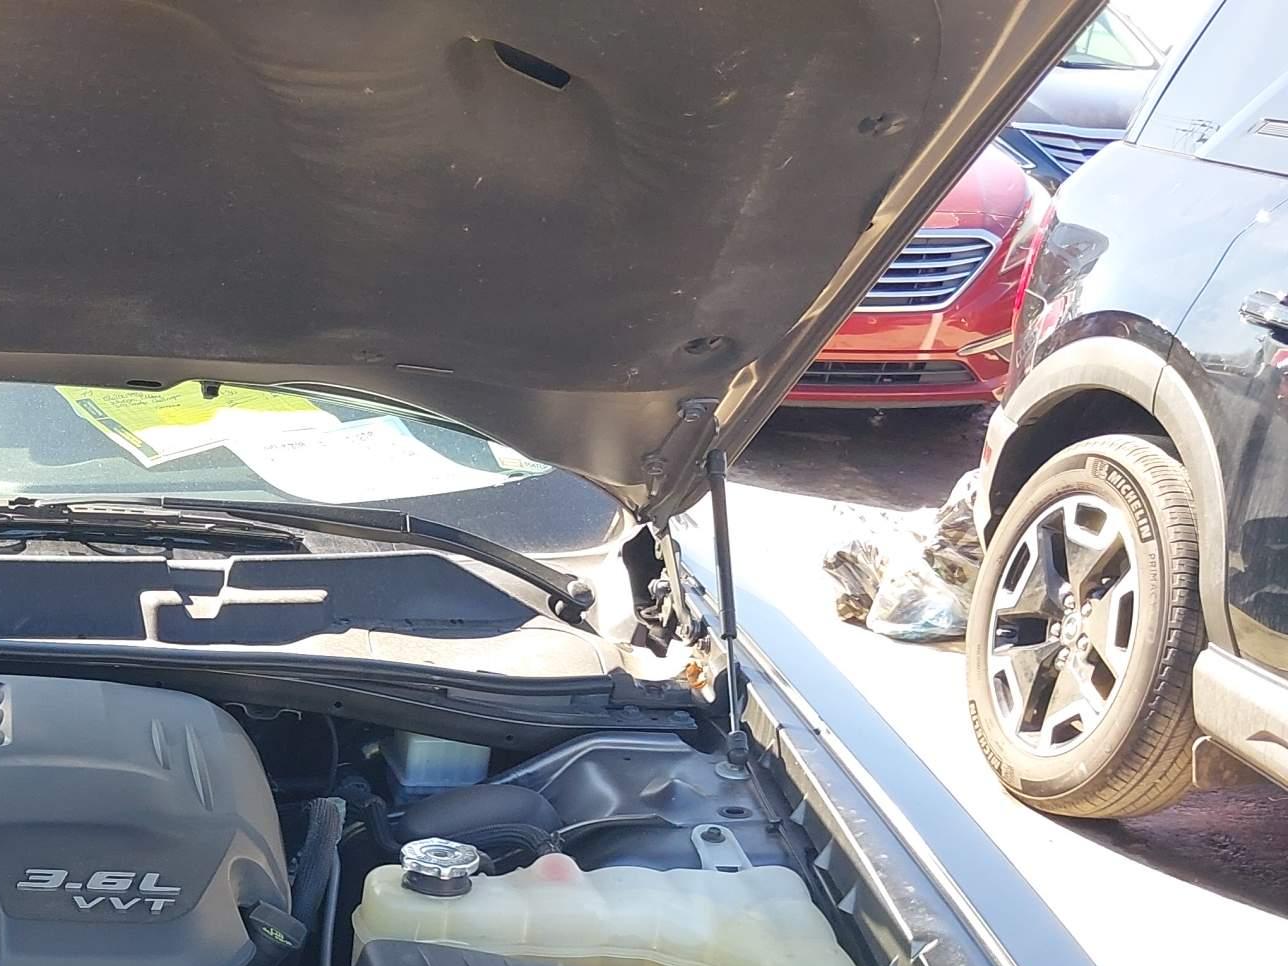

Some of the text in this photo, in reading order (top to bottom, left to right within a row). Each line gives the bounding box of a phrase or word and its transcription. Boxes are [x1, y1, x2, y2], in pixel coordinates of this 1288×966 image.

[1107, 470, 1152, 540] MICHELIN
[16, 868, 182, 895] 3.6L
[73, 895, 176, 914] VVT
